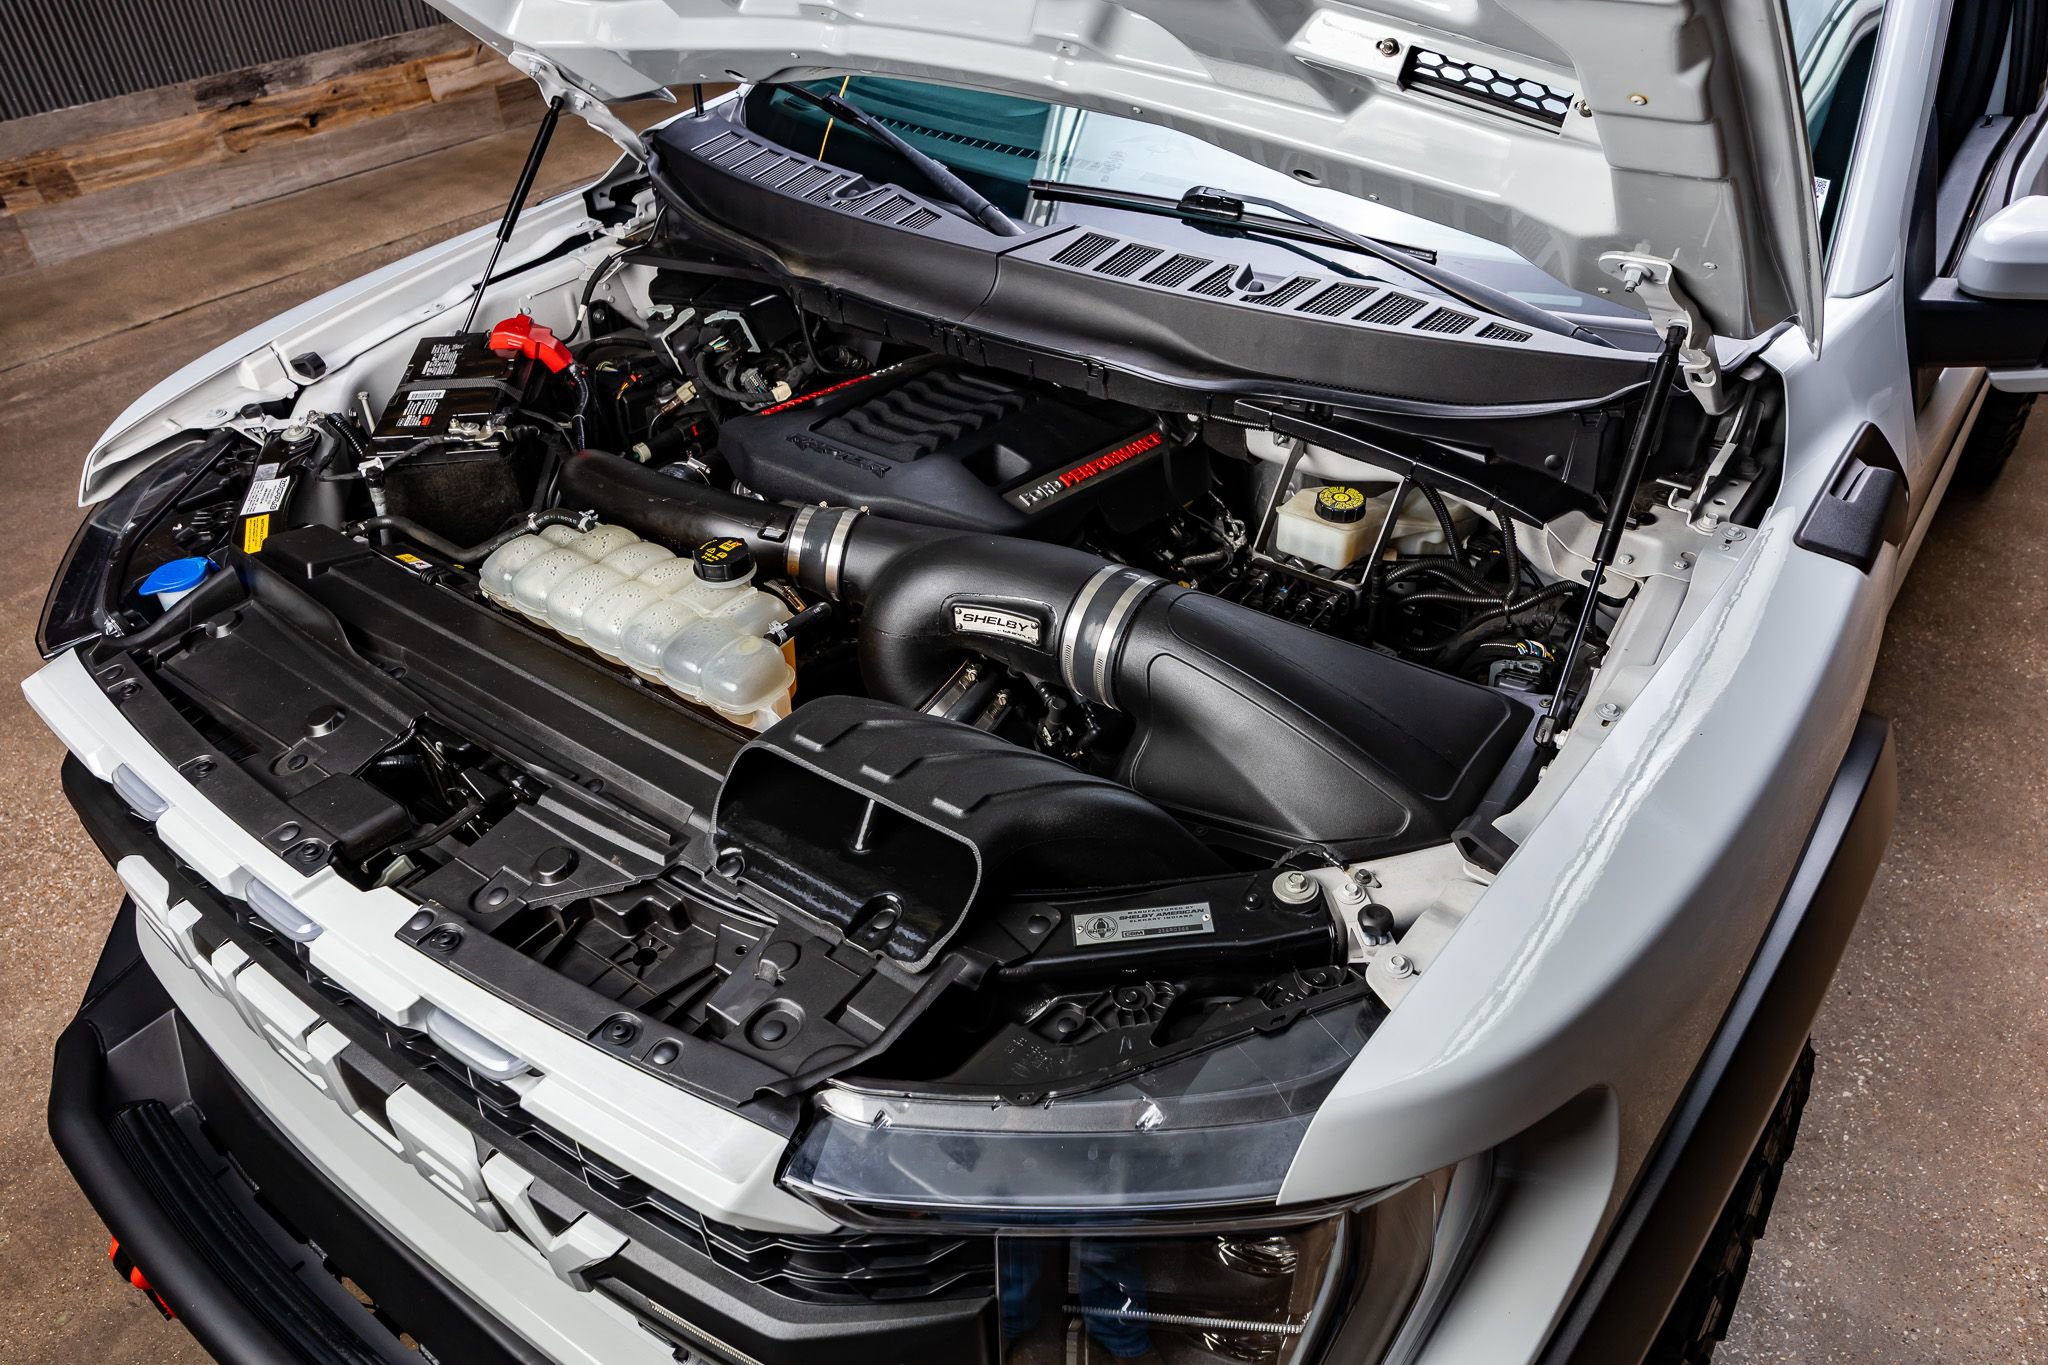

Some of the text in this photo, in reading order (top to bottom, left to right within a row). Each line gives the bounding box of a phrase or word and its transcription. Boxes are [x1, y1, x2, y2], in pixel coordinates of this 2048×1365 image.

[1018, 431, 1163, 507] FORD PERFORMANCE
[962, 613, 1029, 632] SHELBY
[1119, 908, 1205, 921] SHELBY AMERICAN
[1127, 906, 1183, 915] MANUFACTURED
